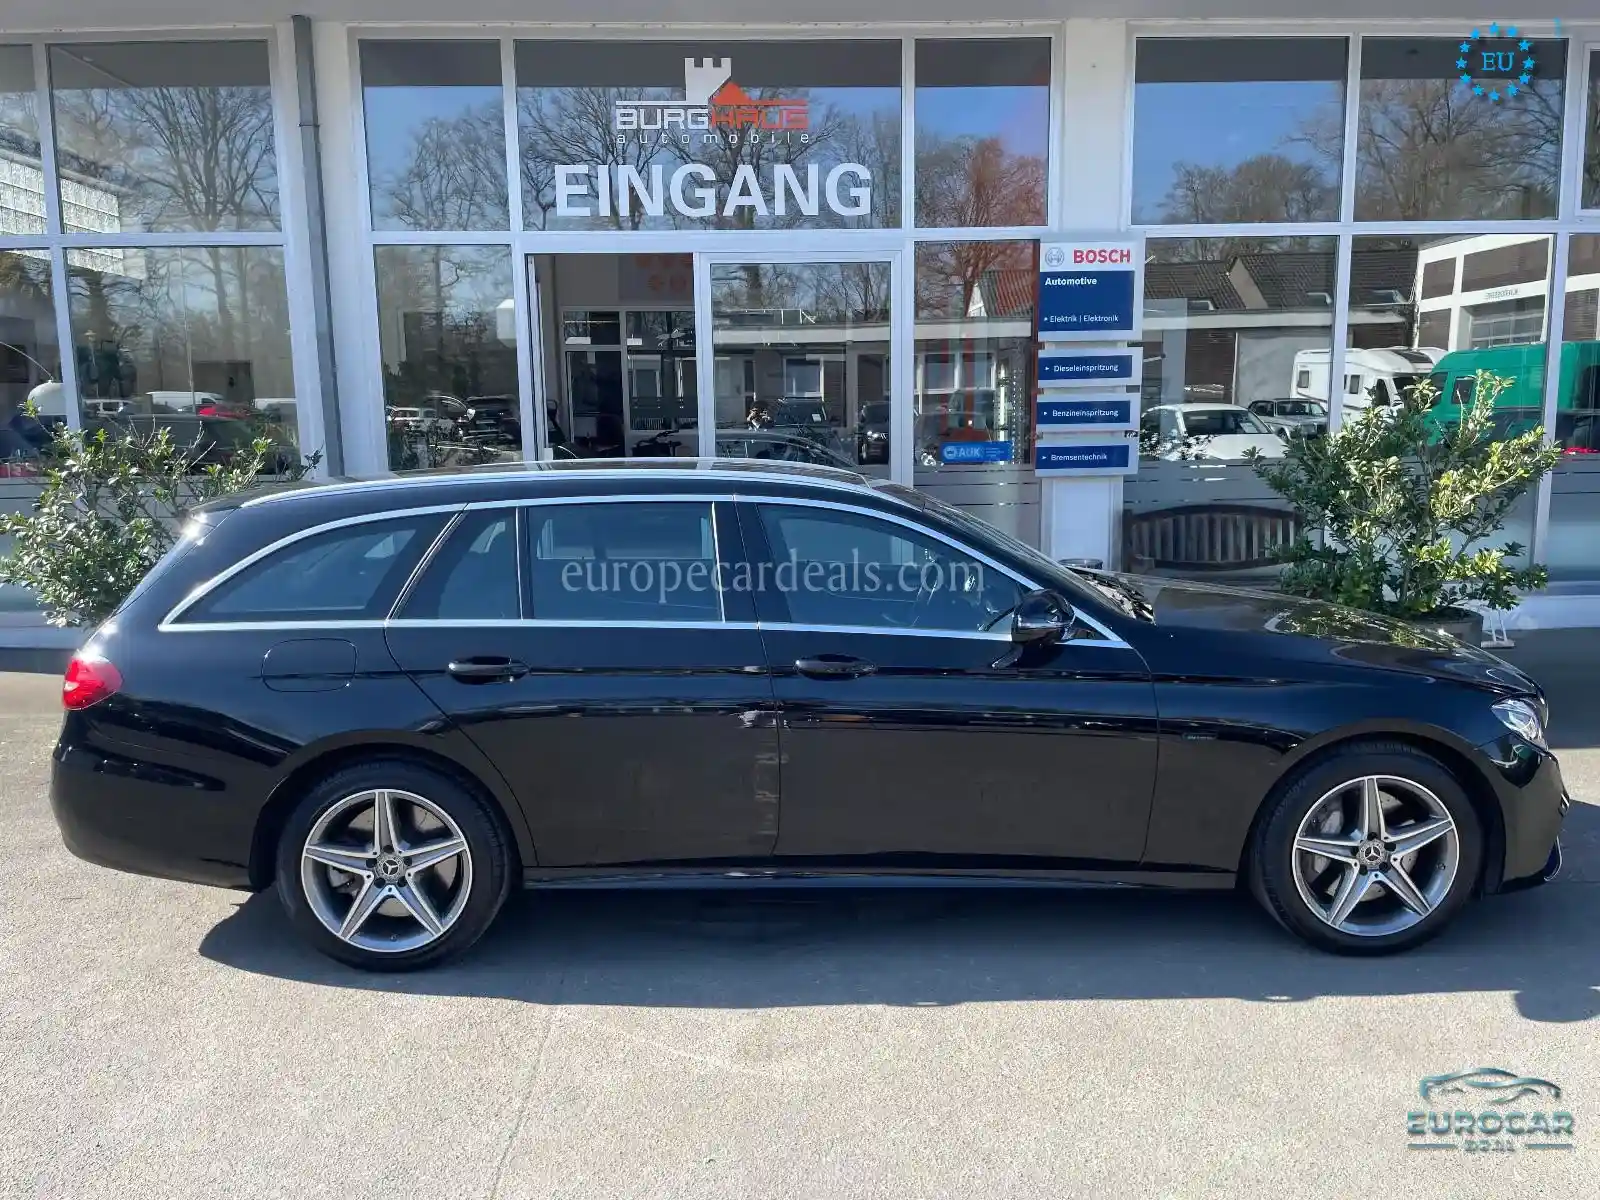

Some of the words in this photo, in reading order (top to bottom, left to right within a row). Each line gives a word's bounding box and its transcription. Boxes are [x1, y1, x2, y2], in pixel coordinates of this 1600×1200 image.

[615, 108, 809, 130] BURGHAUS
[616, 131, 810, 144] automobile
[555, 163, 872, 217] EINGANG
[1073, 249, 1131, 264] BOSCH
[1045, 277, 1098, 286] Automotive
[1050, 314, 1077, 323] Elektrik
[1083, 313, 1119, 323] Elektronik
[1053, 364, 1119, 373] Dieseleinspritzung
[1052, 409, 1119, 418] Benzineinspritzung
[1050, 452, 1108, 461] Bremsentechnik
